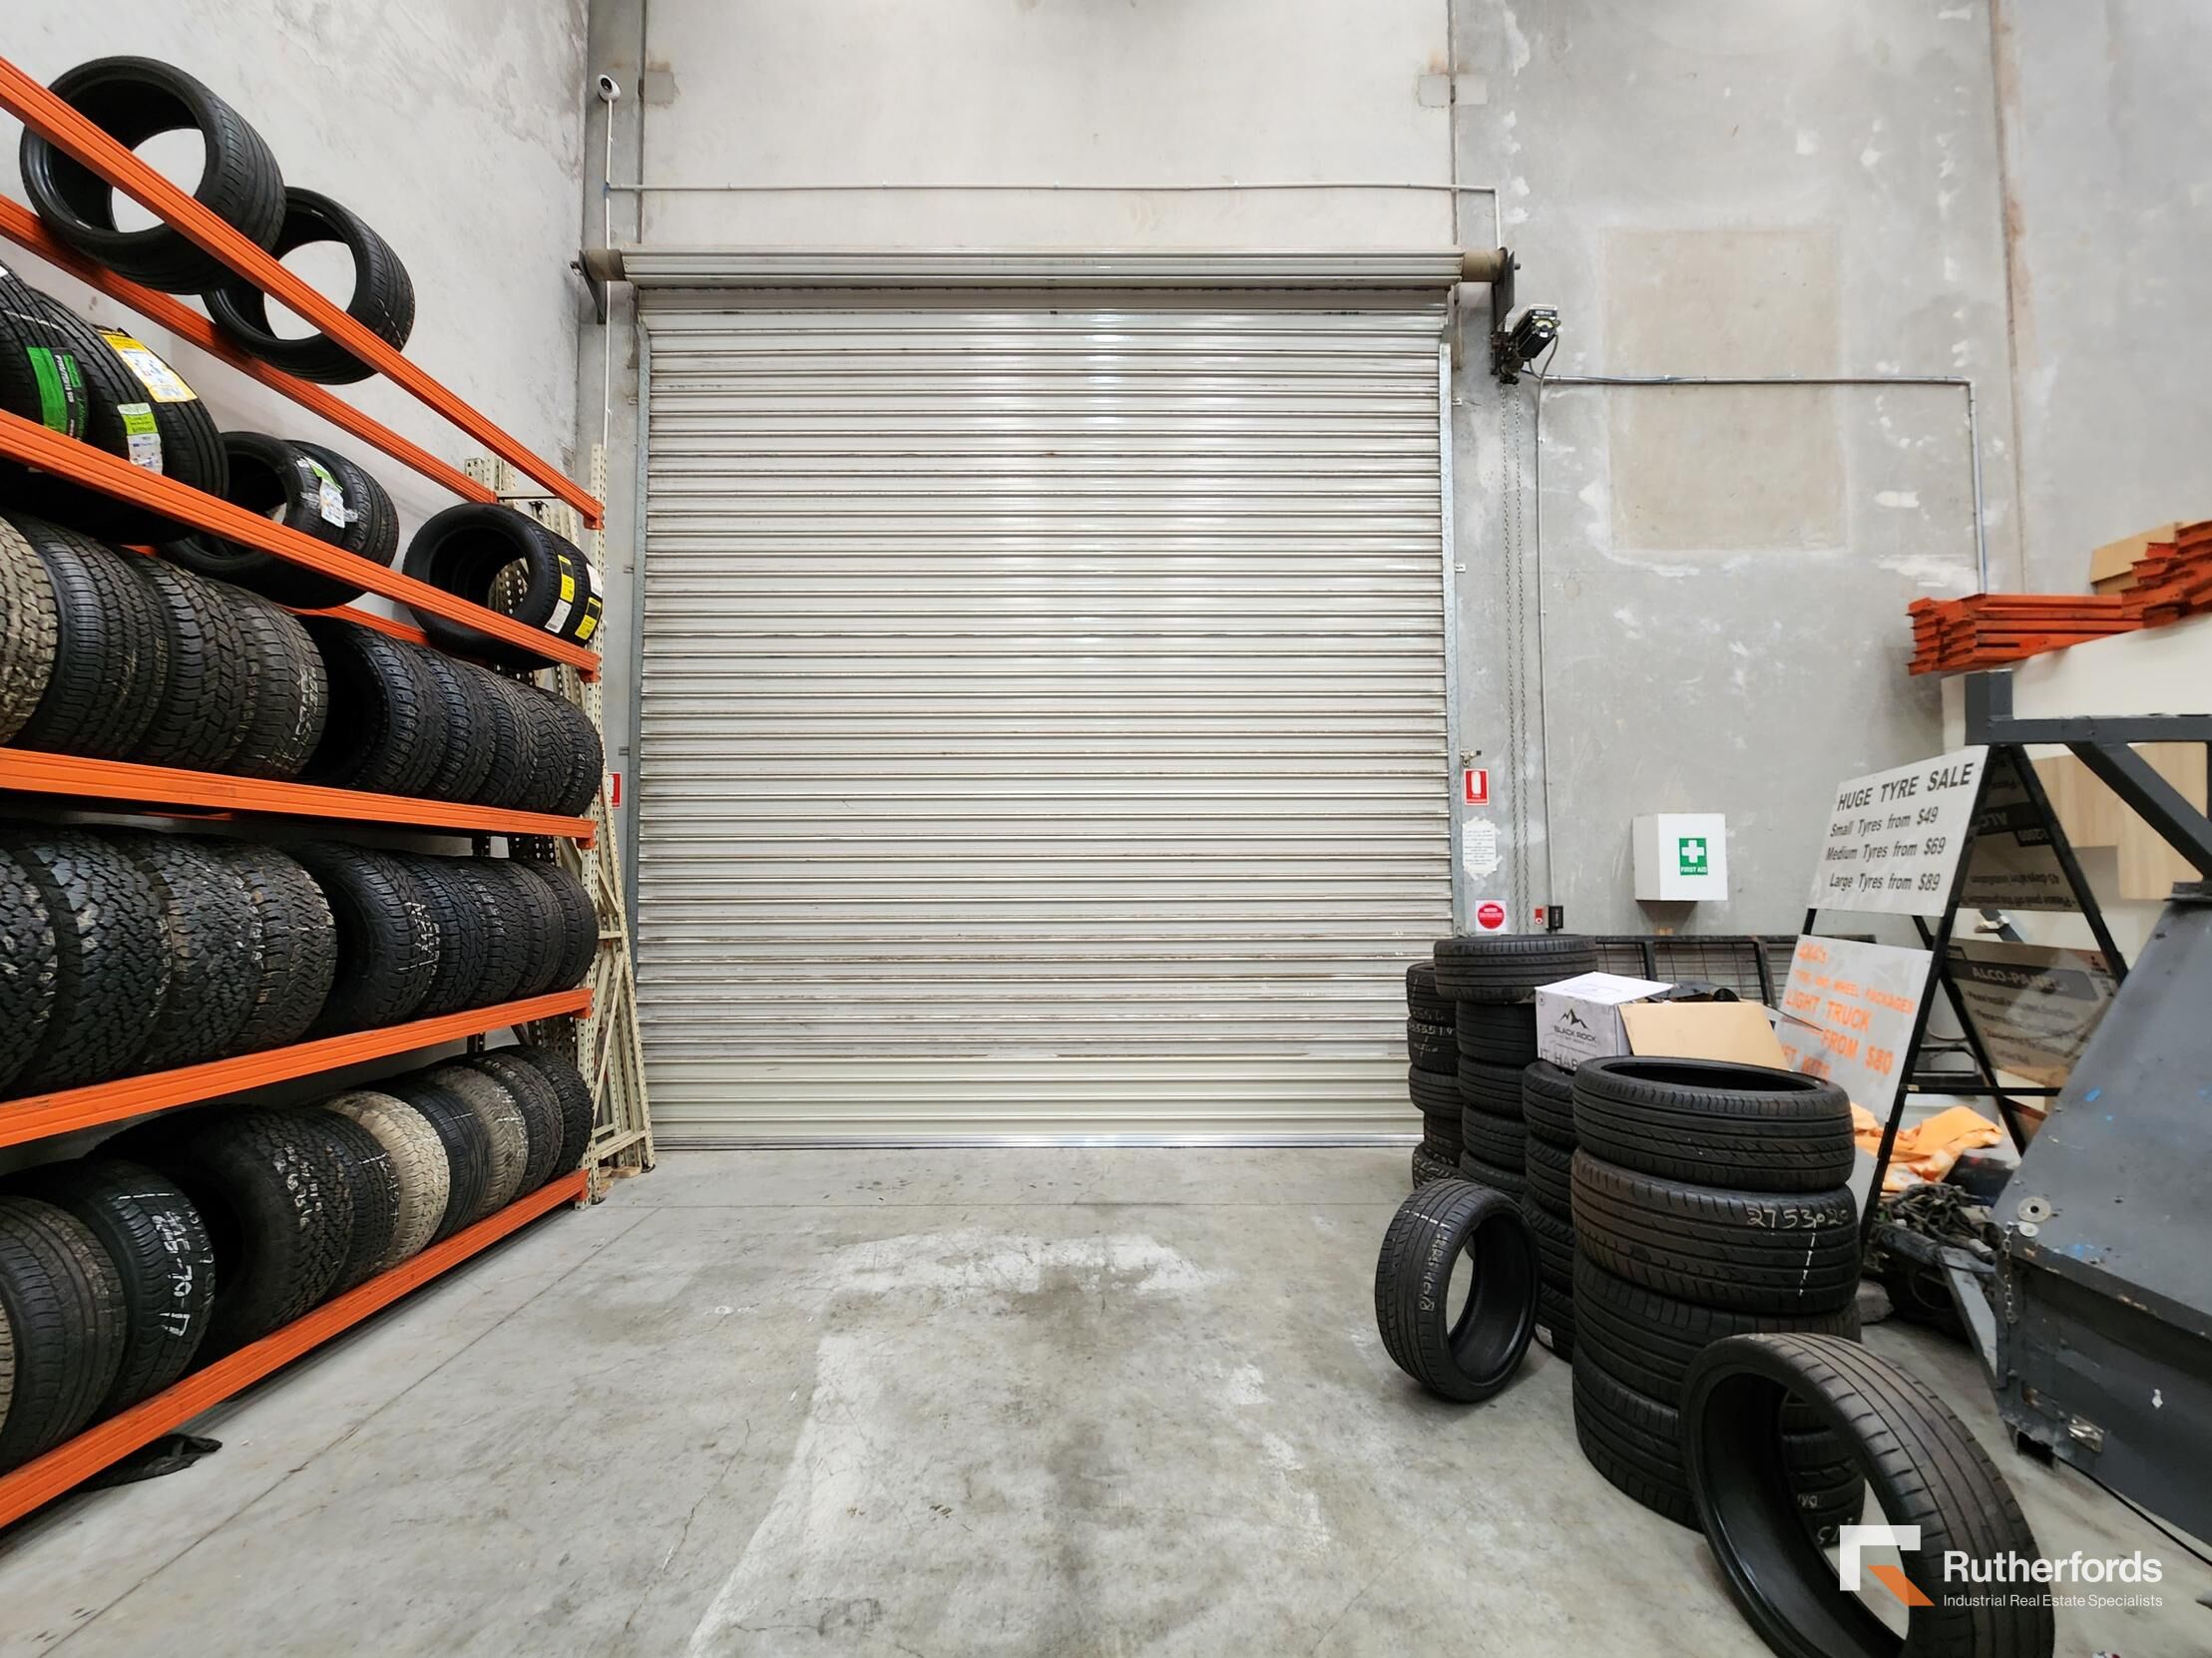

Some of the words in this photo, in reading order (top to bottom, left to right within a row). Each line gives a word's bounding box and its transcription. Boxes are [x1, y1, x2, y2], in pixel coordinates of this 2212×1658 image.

[1837, 787, 1873, 811] HUGE
[1881, 776, 1920, 802] TYRE
[1927, 762, 1975, 792] SALE
[1830, 820, 1855, 837] Small
[1858, 818, 1883, 837] Tyres
[1887, 813, 1911, 830] from
[1917, 806, 1939, 826] $49
[1826, 845, 1858, 861] Medium
[1863, 843, 1888, 863] Tyres
[1893, 840, 1918, 857] from
[1924, 837, 1947, 856] $69
[1830, 873, 1853, 891] Large
[1859, 873, 1883, 892] Tyres
[1888, 873, 1912, 890] from
[1918, 873, 1941, 892] $89
[1785, 990, 1821, 1013] LIGHT
[1826, 1000, 1872, 1035] TRUCK
[1820, 1029, 1859, 1060] FROM
